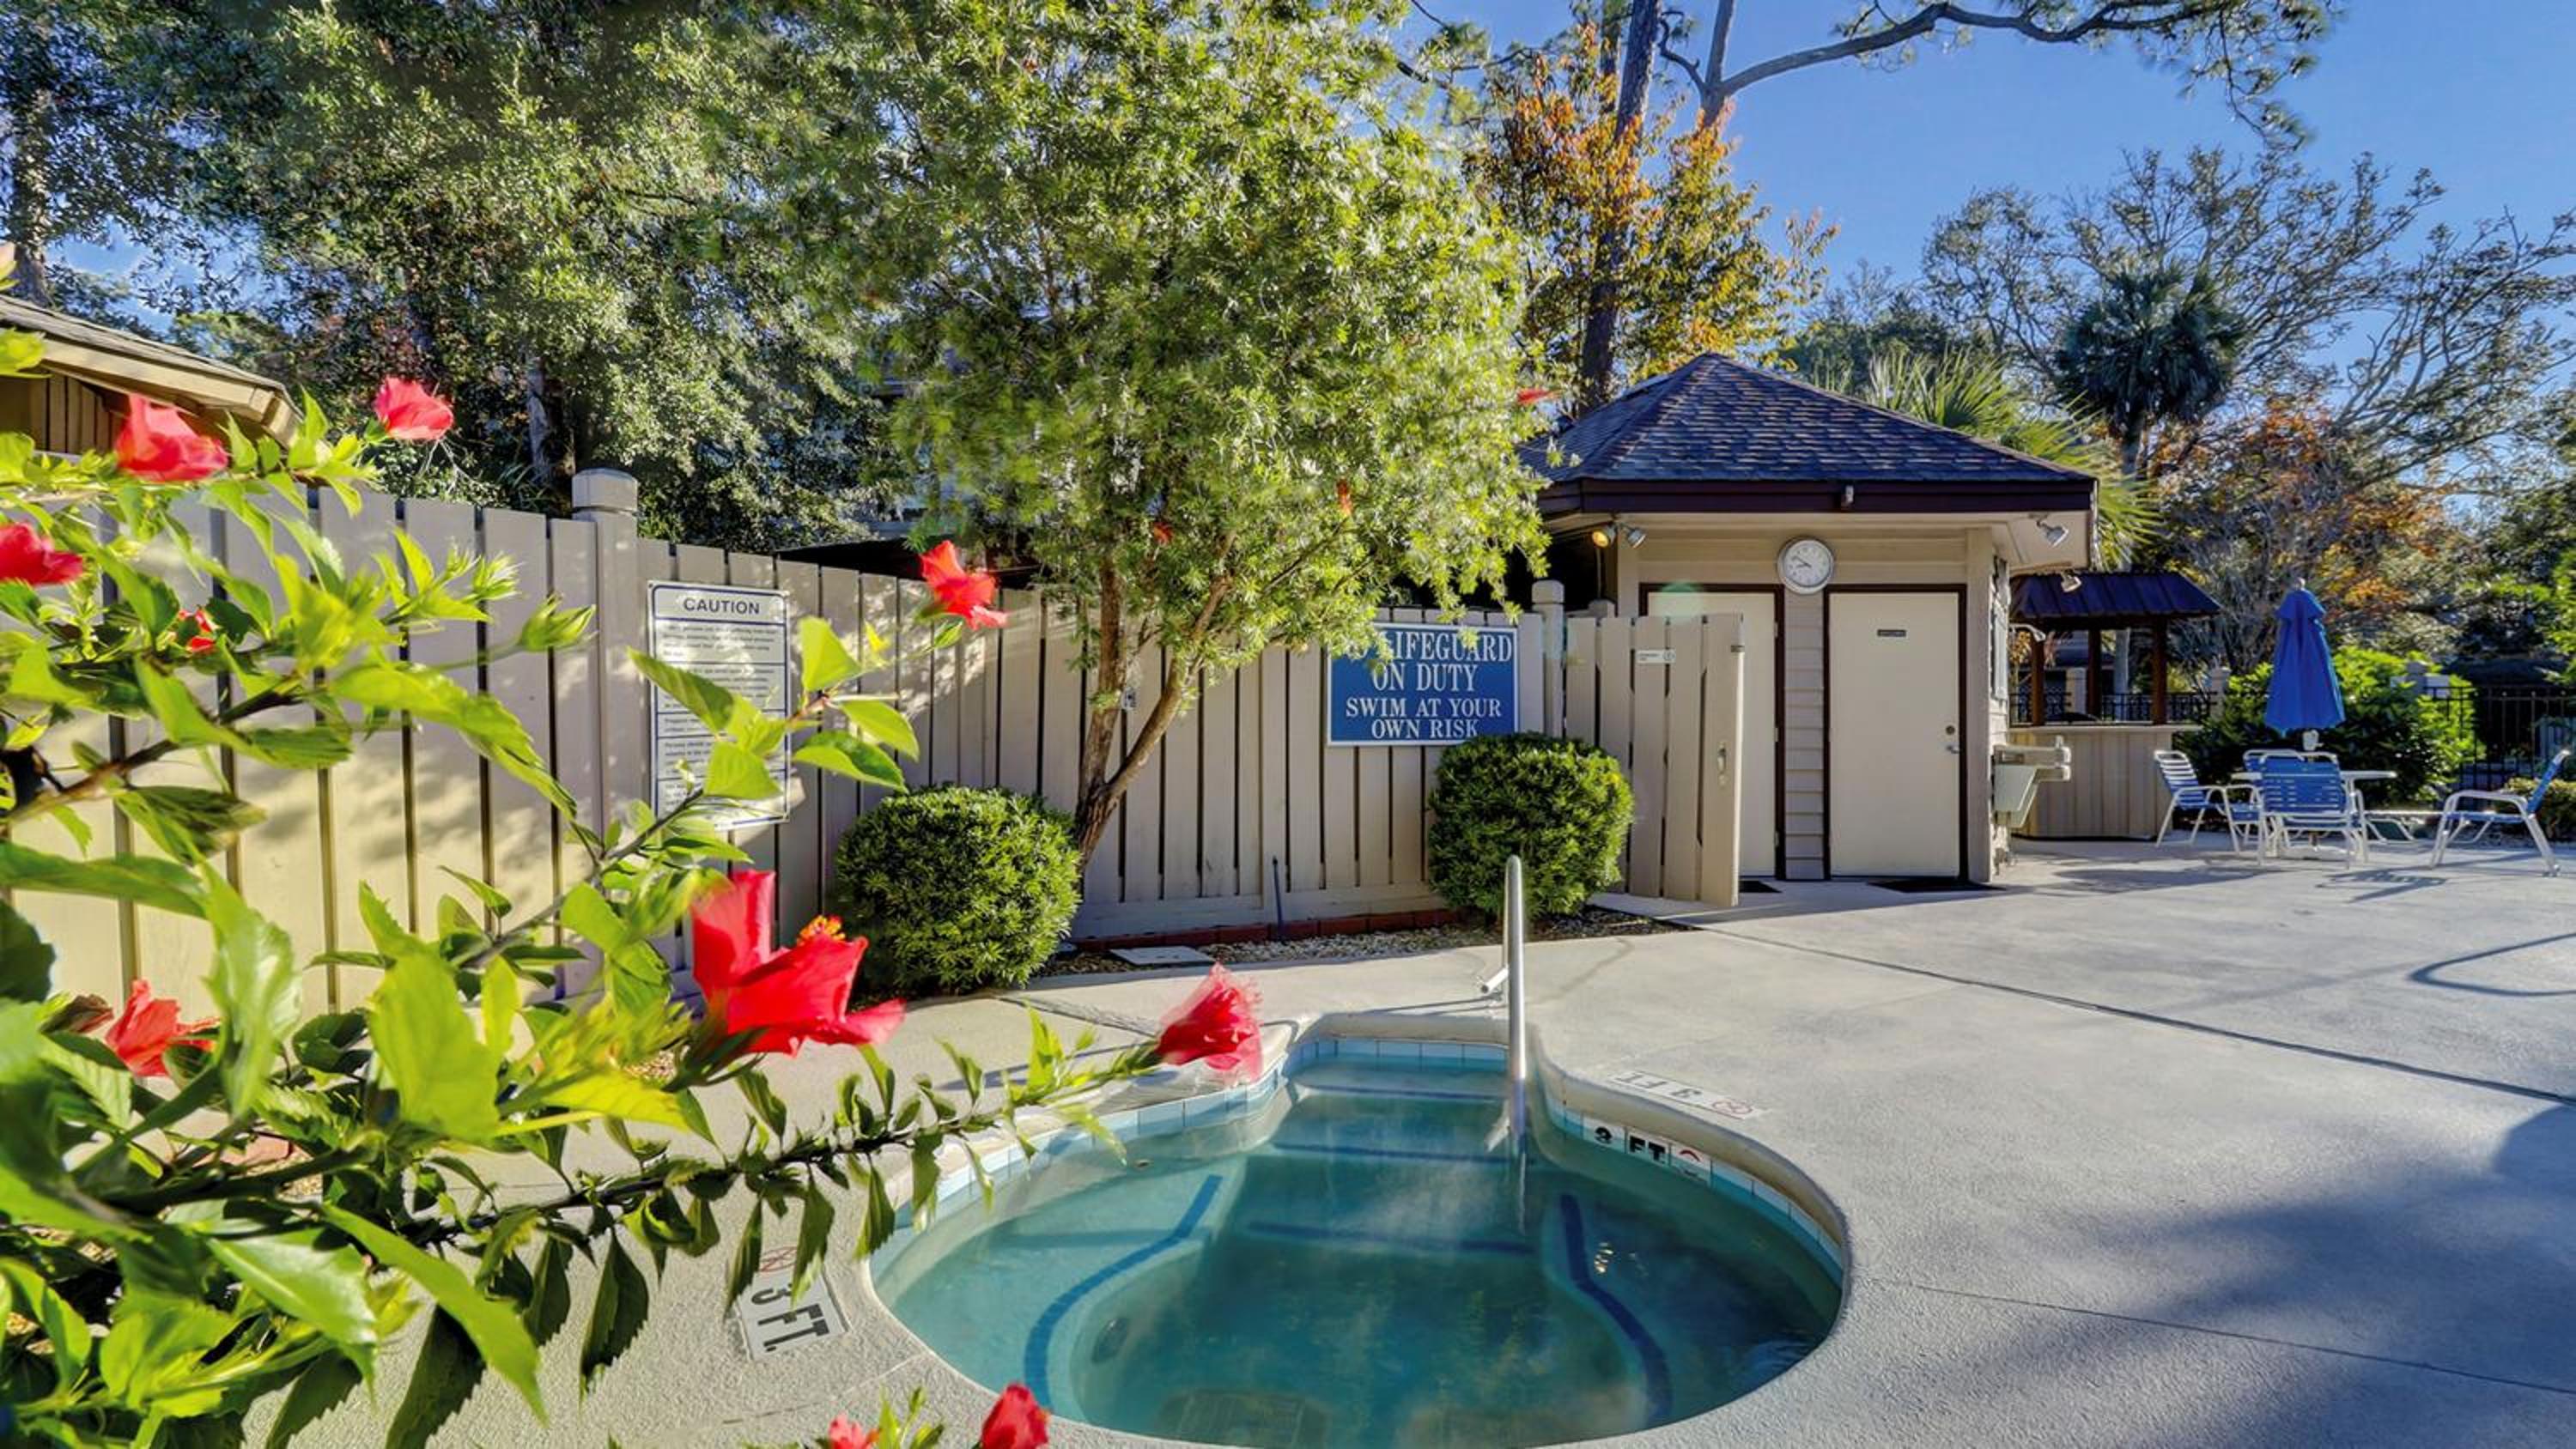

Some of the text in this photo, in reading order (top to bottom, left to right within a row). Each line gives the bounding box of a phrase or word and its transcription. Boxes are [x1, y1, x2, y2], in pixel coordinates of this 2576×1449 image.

[683, 597, 760, 615] CAUTION
[1379, 631, 1512, 662] IFEGUARD
[1373, 662, 1478, 692] ON DUTY
[1346, 697, 1502, 718] SWIM AT YOUR
[1371, 718, 1479, 739] OWN RISK
